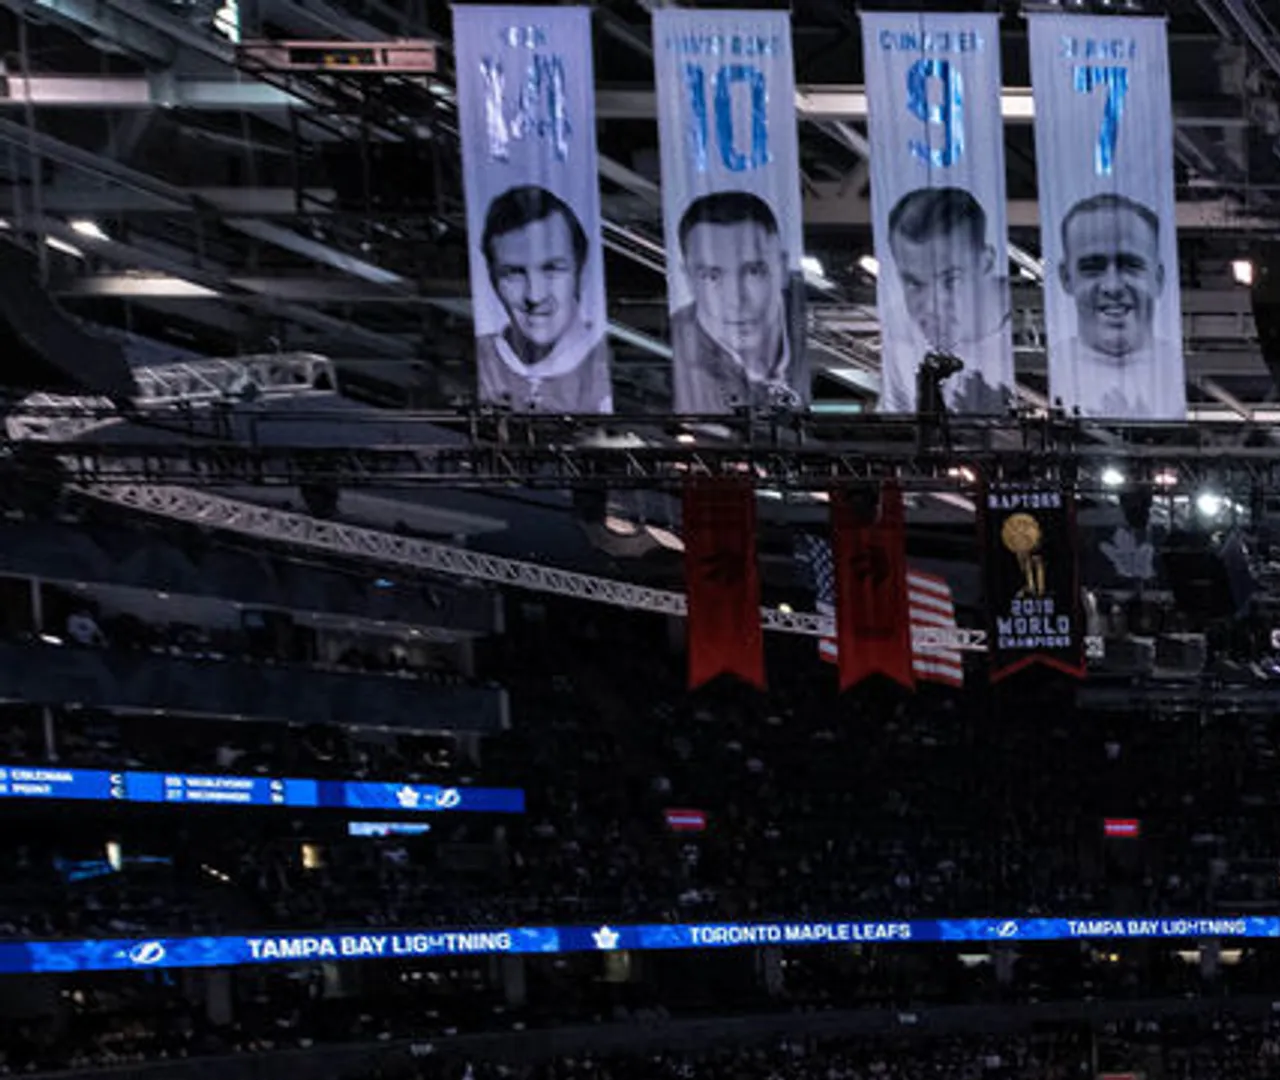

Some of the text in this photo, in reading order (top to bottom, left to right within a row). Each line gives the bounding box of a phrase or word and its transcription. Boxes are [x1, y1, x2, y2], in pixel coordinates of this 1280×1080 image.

[684, 62, 772, 172] 10
[907, 60, 964, 168] 9
[1075, 66, 1128, 175] 7
[997, 616, 1070, 635] WORLD
[689, 923, 912, 945] TORONTO MAPLE LEAFS
[1067, 920, 1246, 934] TAMPA BAY LIGHTNING
[248, 931, 511, 960] TAMPA BAY LIGHTNING
